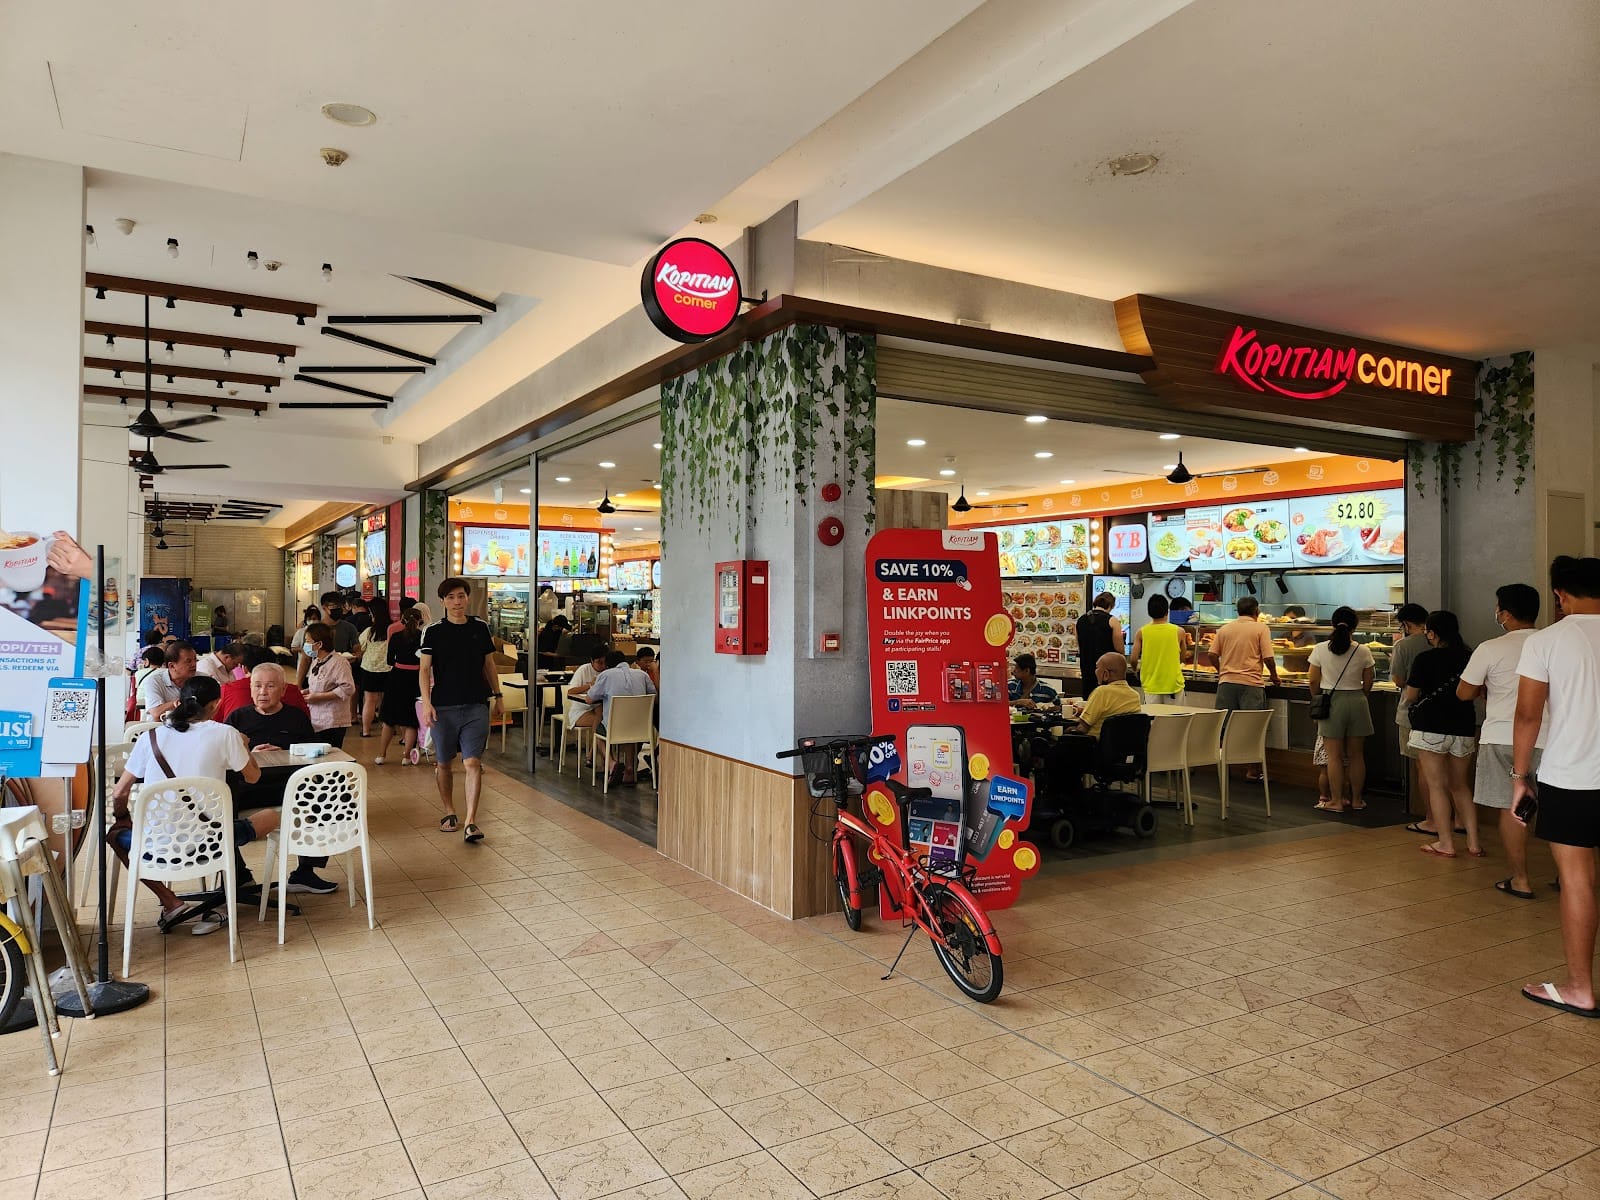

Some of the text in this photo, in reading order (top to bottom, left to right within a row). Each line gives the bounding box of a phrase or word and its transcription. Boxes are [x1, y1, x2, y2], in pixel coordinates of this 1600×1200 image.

[674, 294, 717, 310] corner
[1357, 353, 1452, 396] corner
[1337, 502, 1374, 519] $2.80
[880, 562, 954, 577] SAVE 10%
[882, 588, 938, 602] & EARN
[883, 606, 972, 621] LINKPOINTS
[0, 642, 59, 653] OPI/TEH
[884, 637, 896, 645] Pay
[891, 646, 926, 654] participating
[868, 741, 895, 769] 0%
[885, 748, 897, 759] OFF
[997, 785, 1019, 796] EARN
[990, 794, 1025, 805] LINKPOINTS
